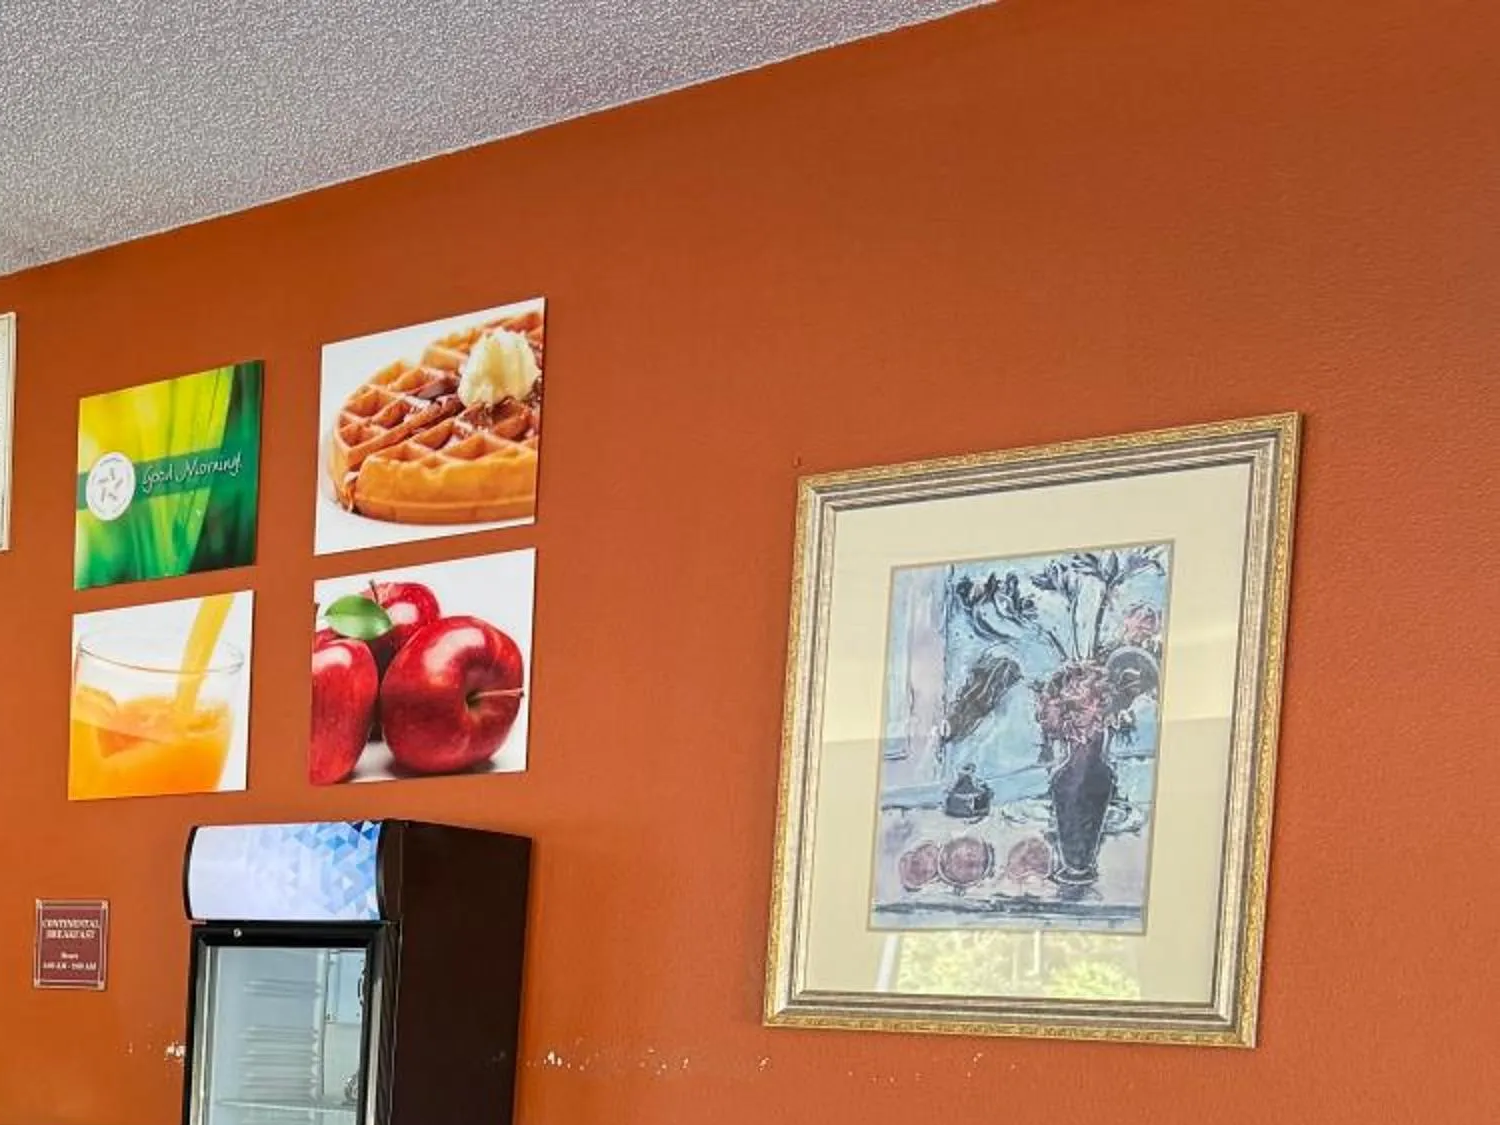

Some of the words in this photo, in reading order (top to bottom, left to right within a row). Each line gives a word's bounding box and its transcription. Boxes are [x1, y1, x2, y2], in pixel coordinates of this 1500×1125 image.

[142, 463, 173, 493] Good
[176, 452, 243, 482] Morning!
[41, 918, 101, 929] CONTINENTAL
[46, 929, 96, 939] BREAKFAST
